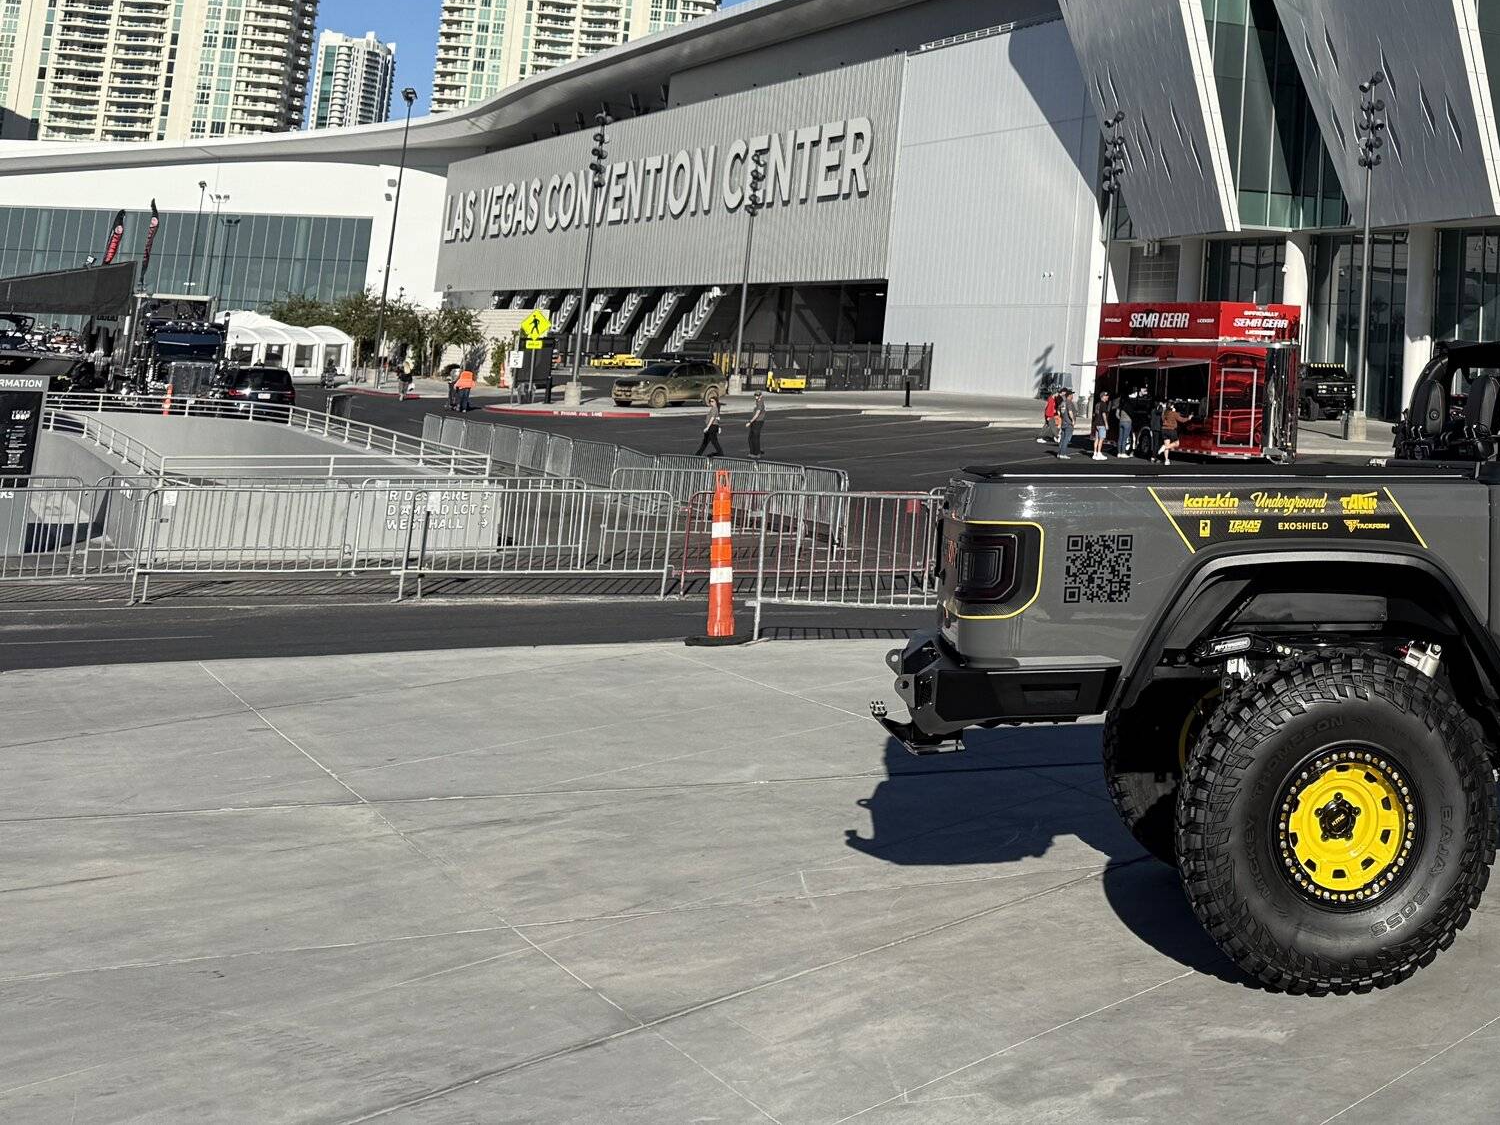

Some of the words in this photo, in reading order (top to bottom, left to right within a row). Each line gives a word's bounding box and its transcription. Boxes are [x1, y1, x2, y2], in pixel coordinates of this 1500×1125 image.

[444, 190, 477, 243] LAS
[480, 178, 542, 239] VEGAS
[545, 144, 717, 232] CONVENTION
[723, 117, 873, 210] CENTER
[1129, 313, 1160, 328] SEMA
[1160, 313, 1190, 328] GEAR
[1233, 318, 1262, 328] SEMA
[1262, 319, 1289, 328] GEAR
[1183, 492, 1240, 508] katzkin
[1250, 491, 1328, 516] Underground
[1340, 491, 1378, 510] TANK
[453, 504, 477, 515] LOT
[428, 518, 463, 529] HALL
[1229, 520, 1263, 529] TEXAS
[1278, 522, 1329, 530] EXOSHIELD
[1370, 887, 1430, 938] BOSS
